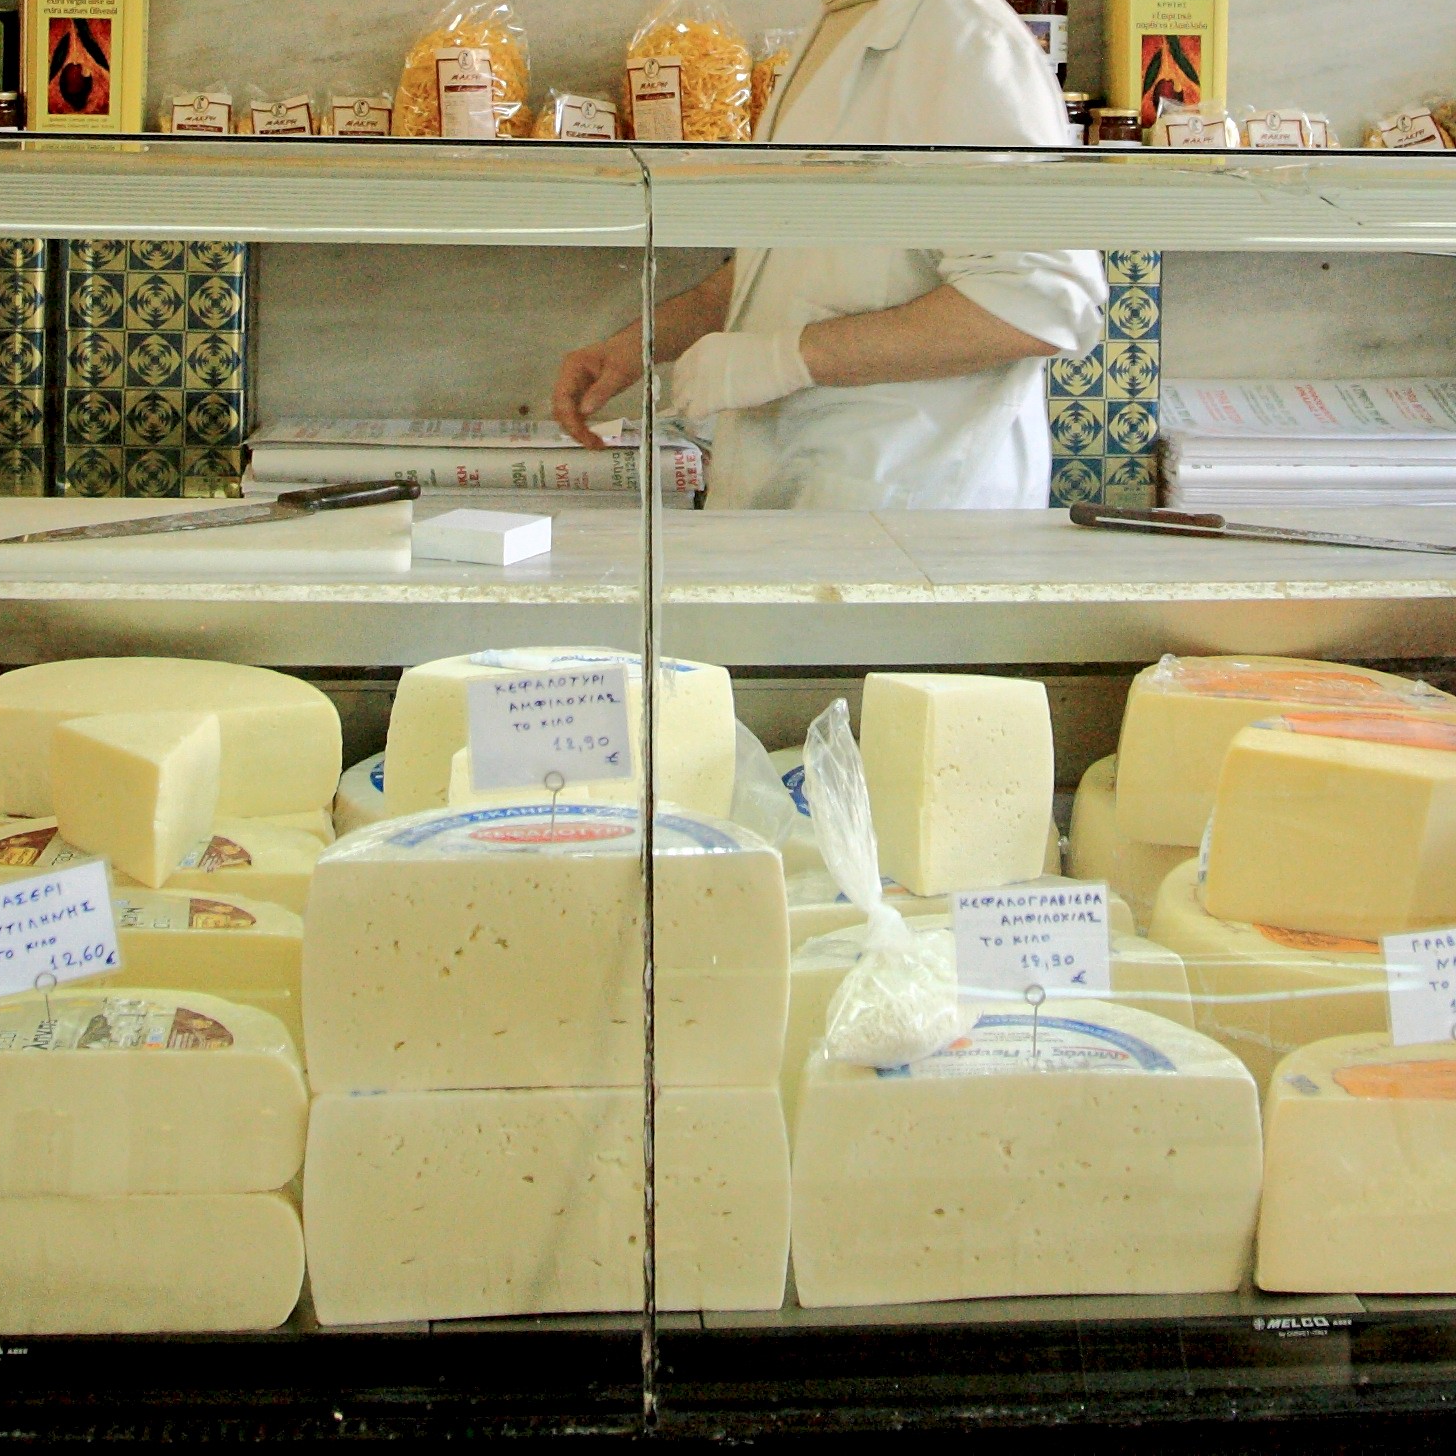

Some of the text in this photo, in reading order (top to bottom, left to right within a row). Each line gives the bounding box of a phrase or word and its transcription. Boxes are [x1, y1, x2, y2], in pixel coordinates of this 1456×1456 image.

[495, 674, 604, 694] ΚΕΦΑΛΟΤΥΡΙ
[509, 694, 620, 712] ΑΜΦΙΛΟΧΙΑΣ
[959, 893, 1102, 909] ΚΕΦΑΛΟΓΡΑΒΙΕΡΑ
[1000, 911, 1101, 926] ΑΜΦΙΛΟΧΙΑΣ
[26, 937, 57, 952] ΚΙΛΟ
[980, 936, 1003, 946] ΤΟ
[1429, 981, 1449, 991] ΤΟ
[1267, 1316, 1330, 1329] MELCO
